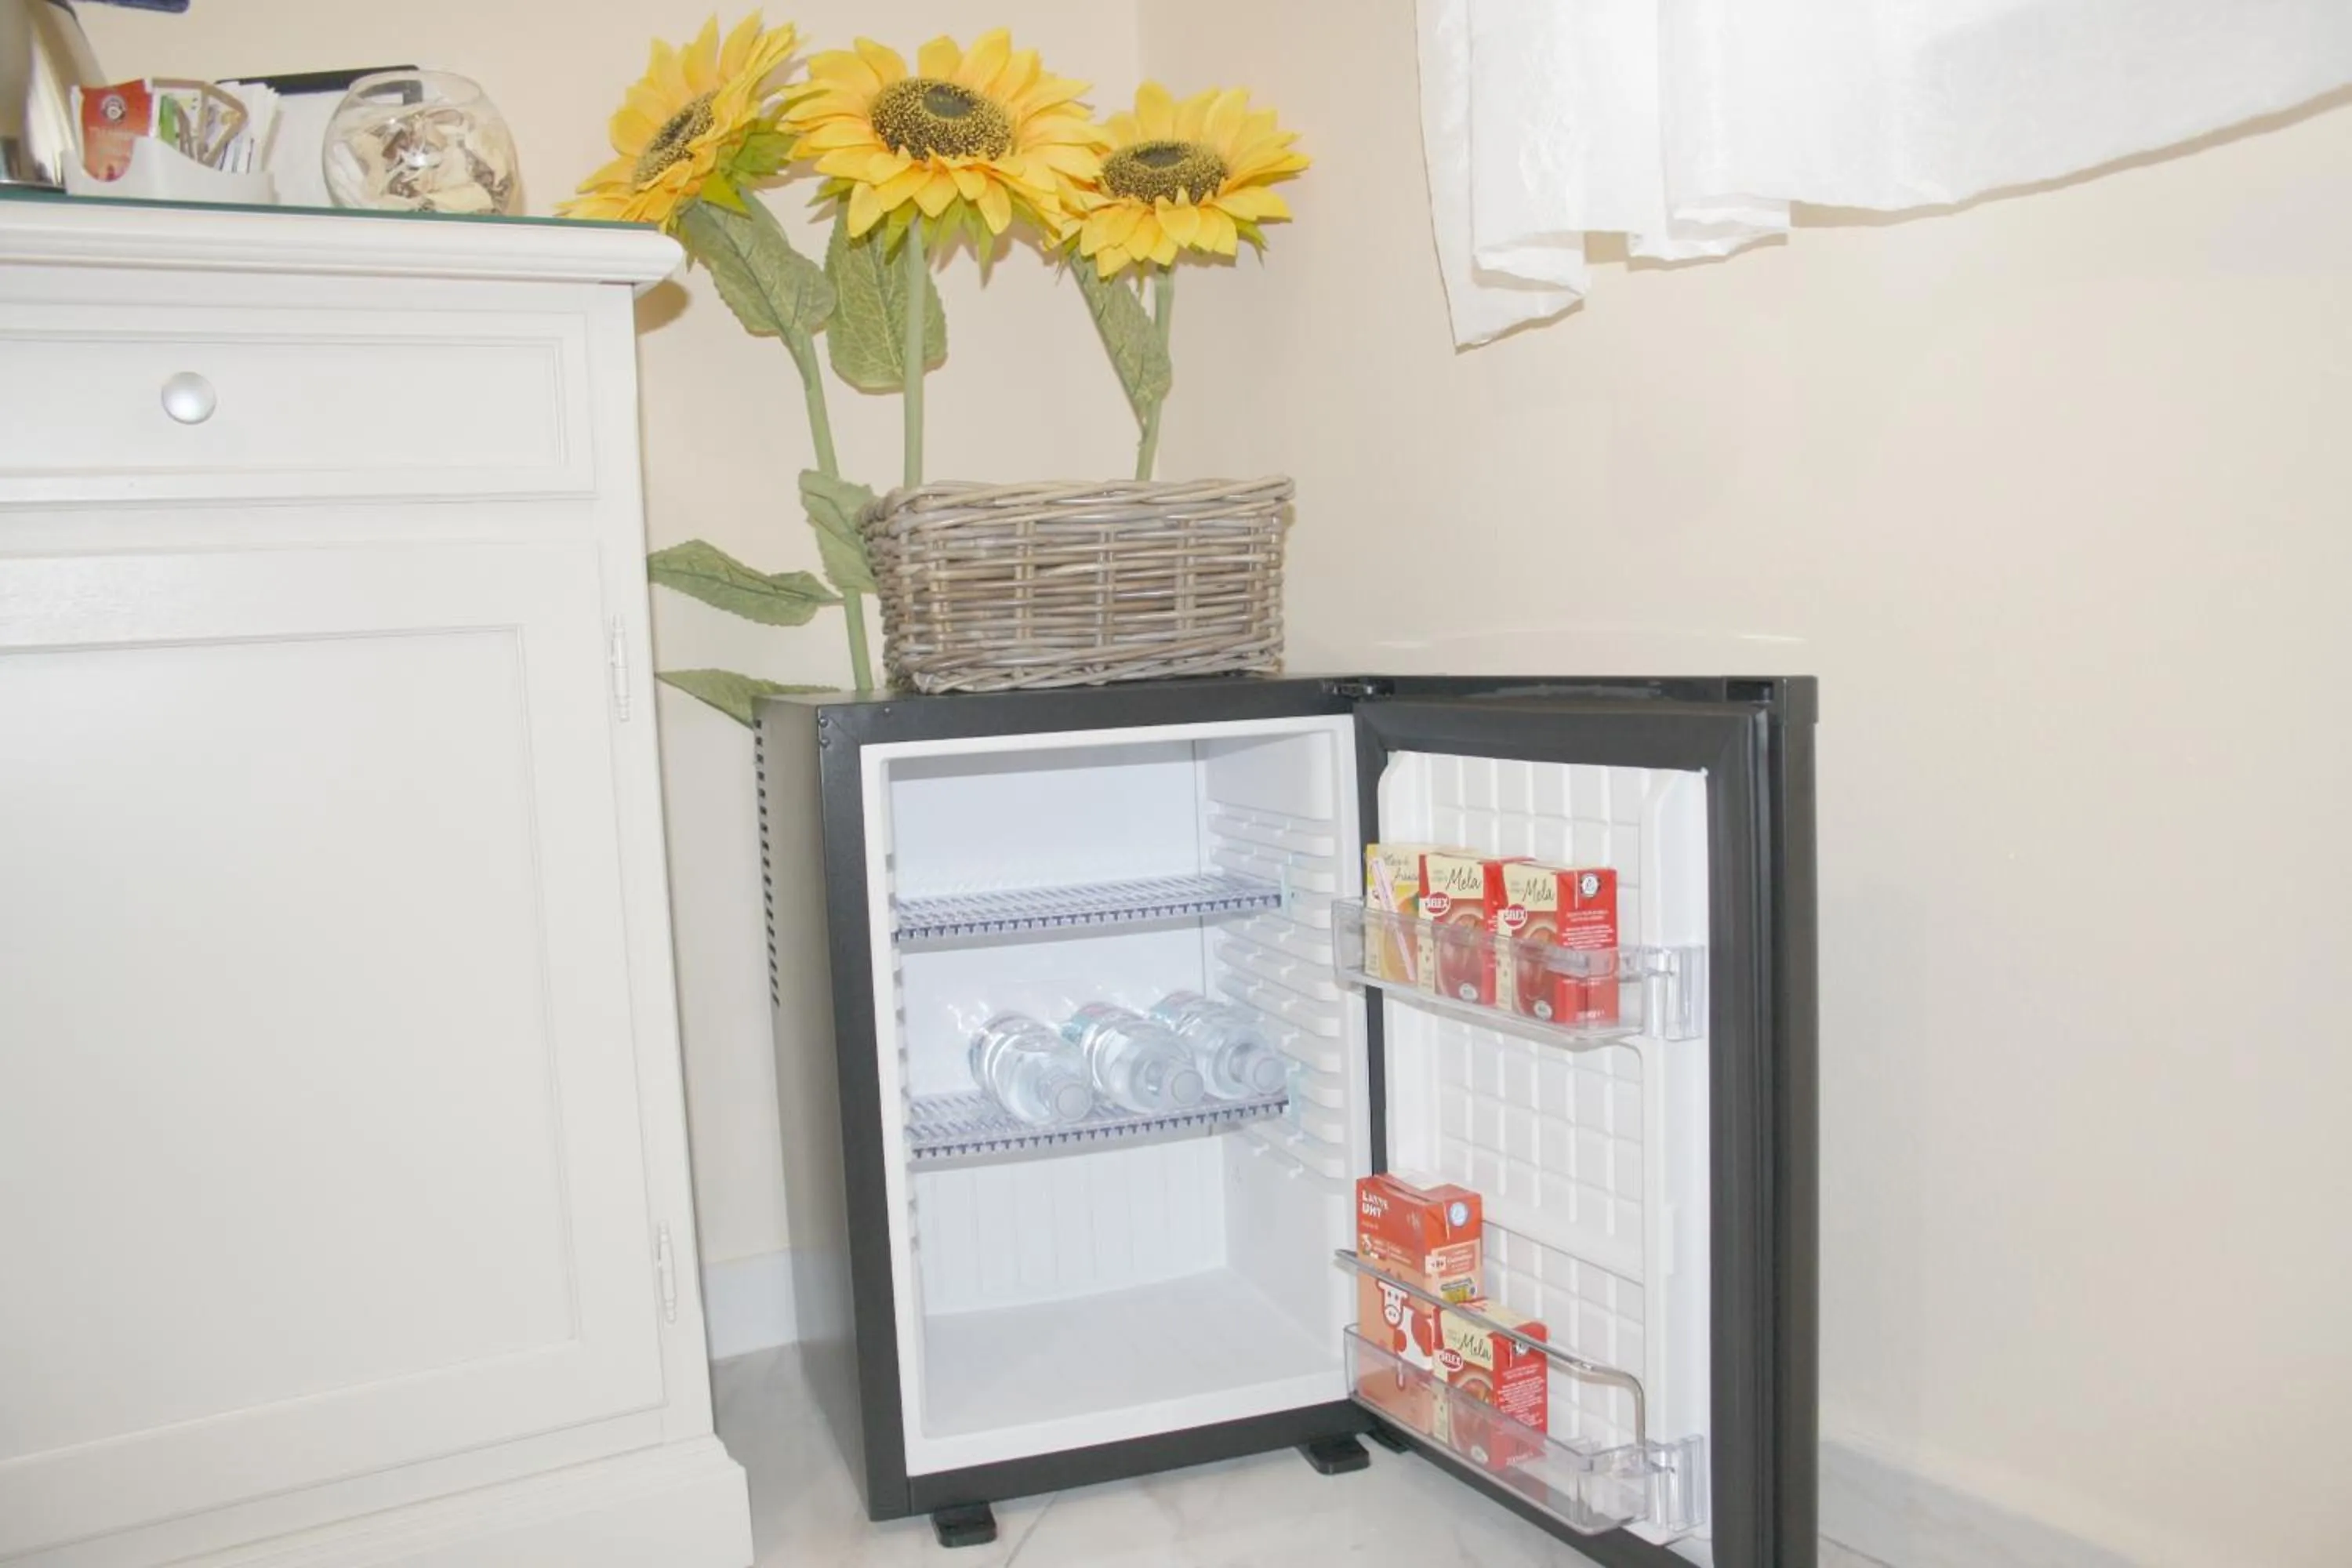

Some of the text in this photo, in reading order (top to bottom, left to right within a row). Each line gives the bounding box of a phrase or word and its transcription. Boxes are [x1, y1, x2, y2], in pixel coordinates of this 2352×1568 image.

[1446, 866, 1481, 891] Mela
[1523, 877, 1554, 902] Mela
[1458, 1333, 1491, 1361] Mela
